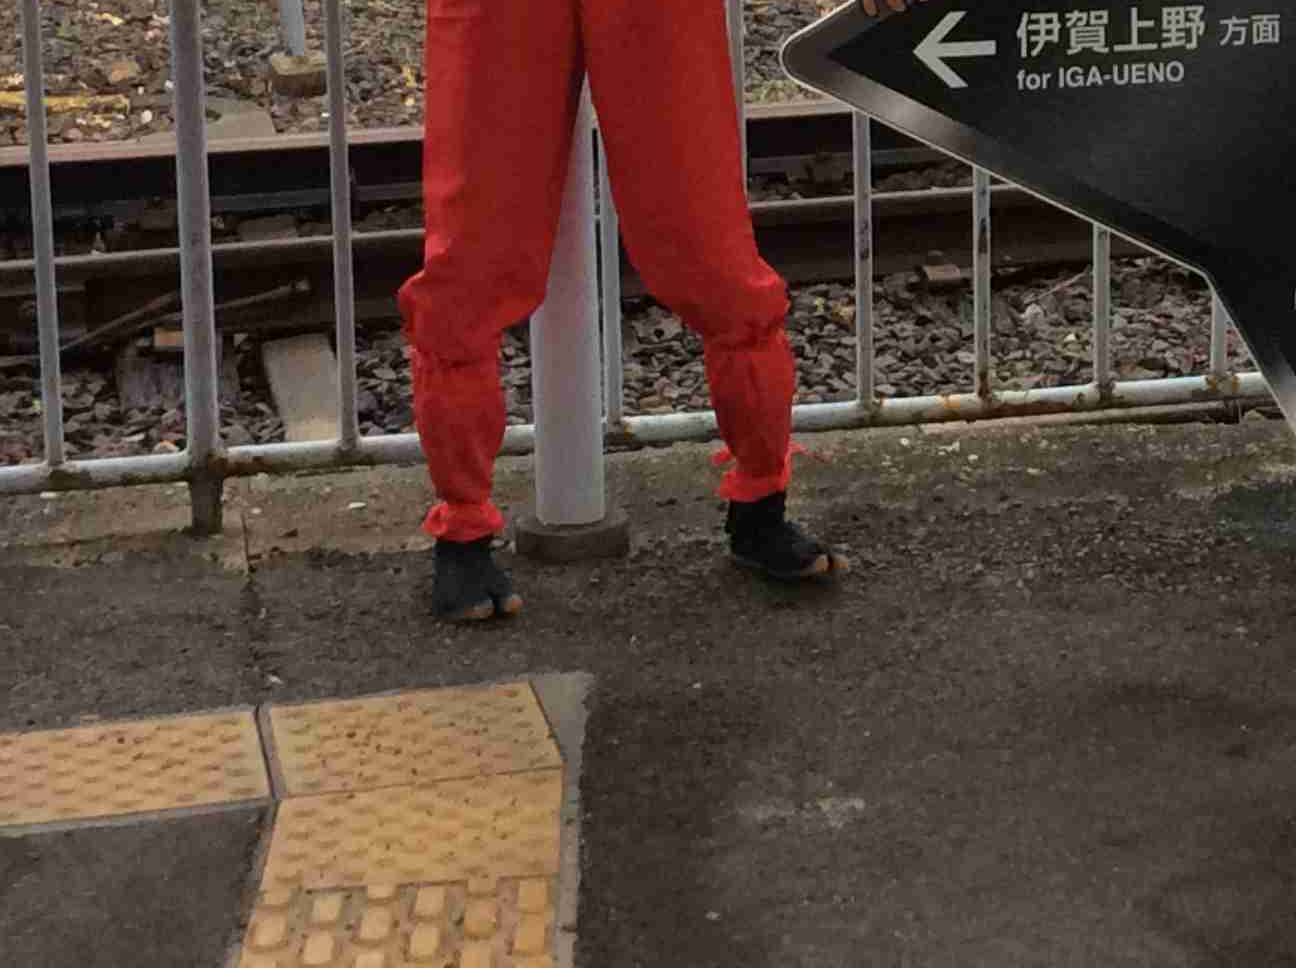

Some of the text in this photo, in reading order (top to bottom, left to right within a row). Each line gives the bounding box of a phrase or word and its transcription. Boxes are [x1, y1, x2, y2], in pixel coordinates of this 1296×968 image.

[1016, 5, 1281, 58] 伊賀上野 方面
[1017, 61, 1185, 90] for IGA-UENO
